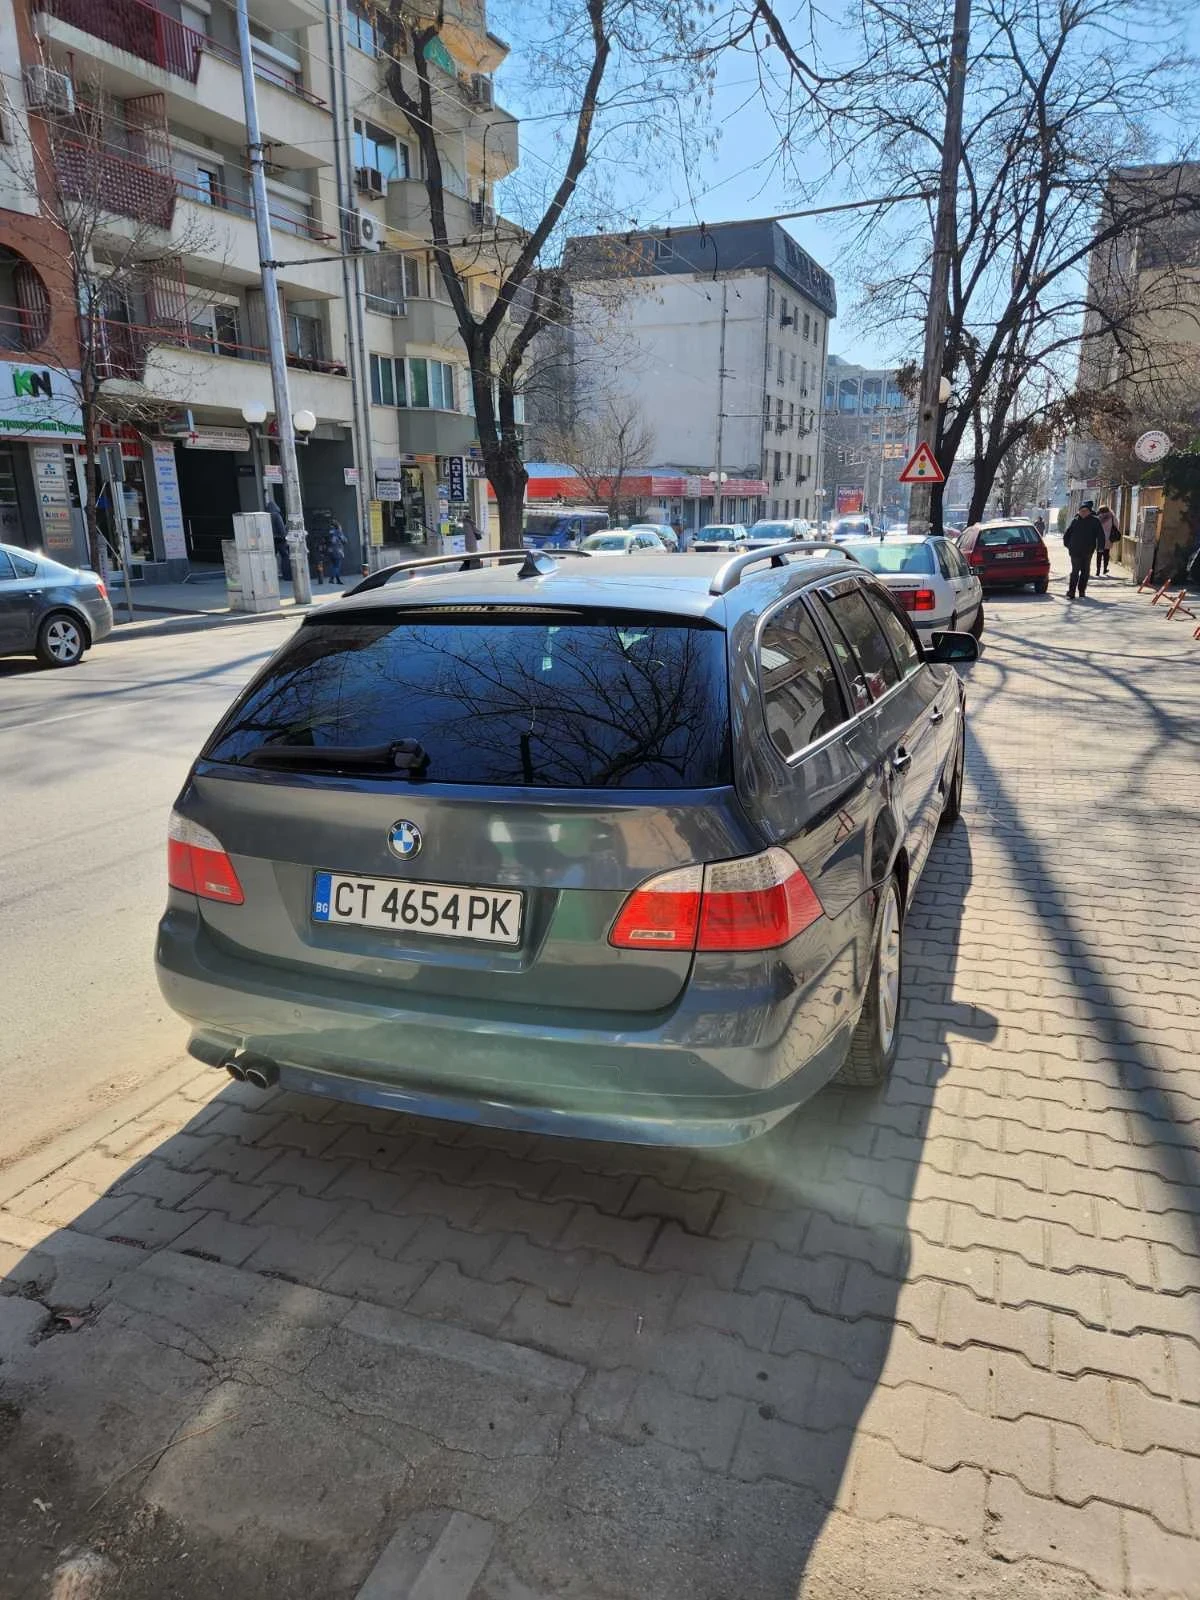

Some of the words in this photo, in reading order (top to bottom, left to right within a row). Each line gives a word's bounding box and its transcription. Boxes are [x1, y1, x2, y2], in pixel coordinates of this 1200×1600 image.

[13, 368, 52, 398] KN
[452, 458, 462, 496] АПТЕКА
[315, 902, 329, 914] BG
[334, 882, 375, 919] CT
[381, 888, 460, 930] 4654
[467, 895, 513, 936] PK
